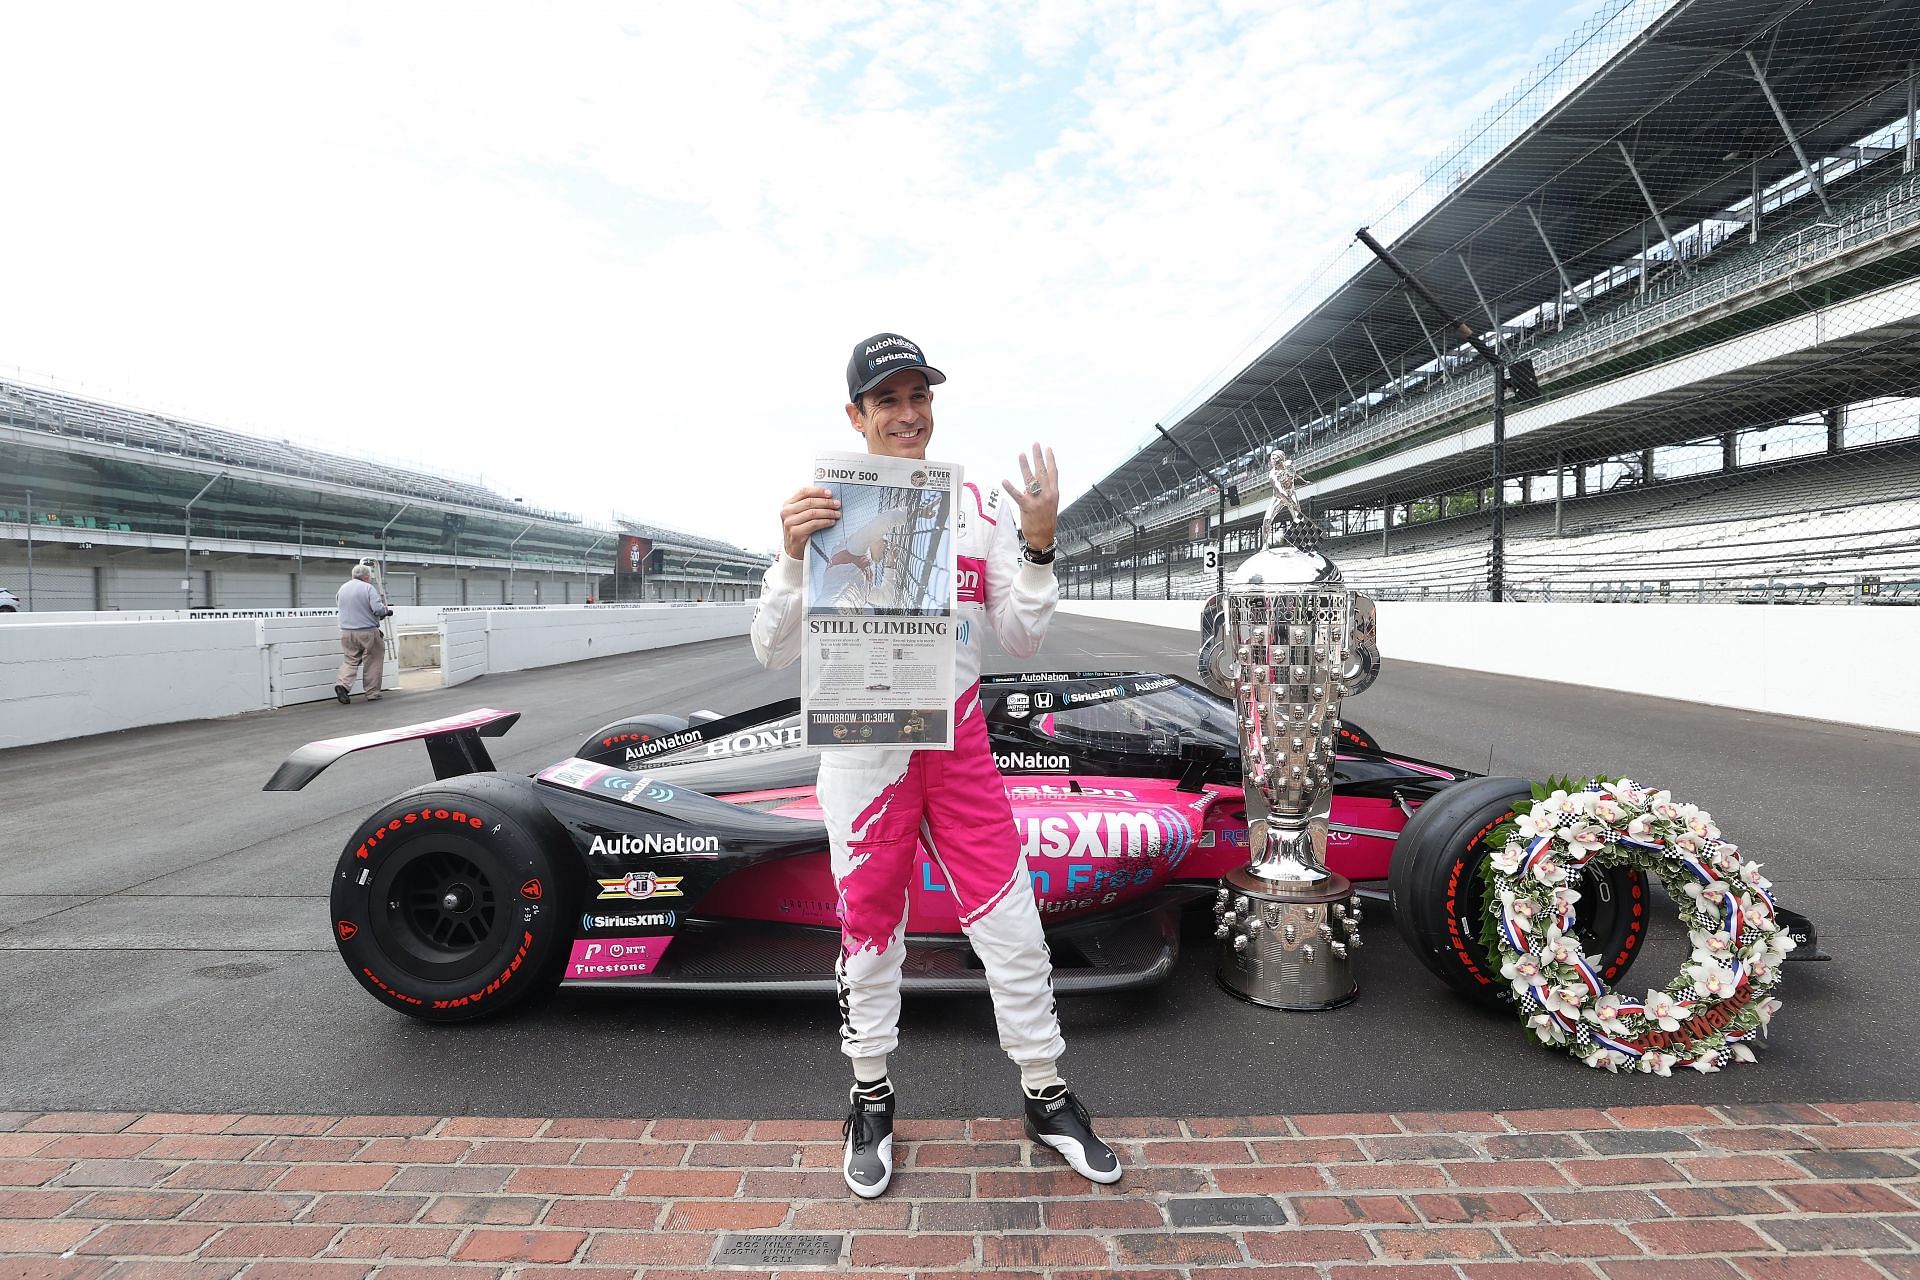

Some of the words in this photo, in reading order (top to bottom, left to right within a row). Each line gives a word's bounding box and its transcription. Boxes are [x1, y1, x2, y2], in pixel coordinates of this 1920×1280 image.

[827, 469, 856, 480] INDY
[858, 471, 879, 482] 500
[928, 470, 950, 478] FEVER
[1206, 551, 1217, 568] 3
[810, 620, 858, 634] STILL
[863, 621, 947, 635] CLIMBING
[1021, 673, 1069, 681] AutoNation
[812, 713, 857, 724] TOMORROW
[861, 713, 895, 723] 10:30PM
[625, 729, 703, 761] AutoNation
[356, 808, 484, 860] Firestone
[589, 833, 719, 855] AutoNation
[1446, 858, 1490, 985] FIREHAWK
[626, 945, 646, 954] NTT
[432, 930, 533, 1009] FIREHAWK
[575, 961, 646, 975] Firestone
[1684, 983, 1755, 1041] Warner
[864, 1102, 886, 1112] PUMA
[1045, 1097, 1066, 1113] PUMA
